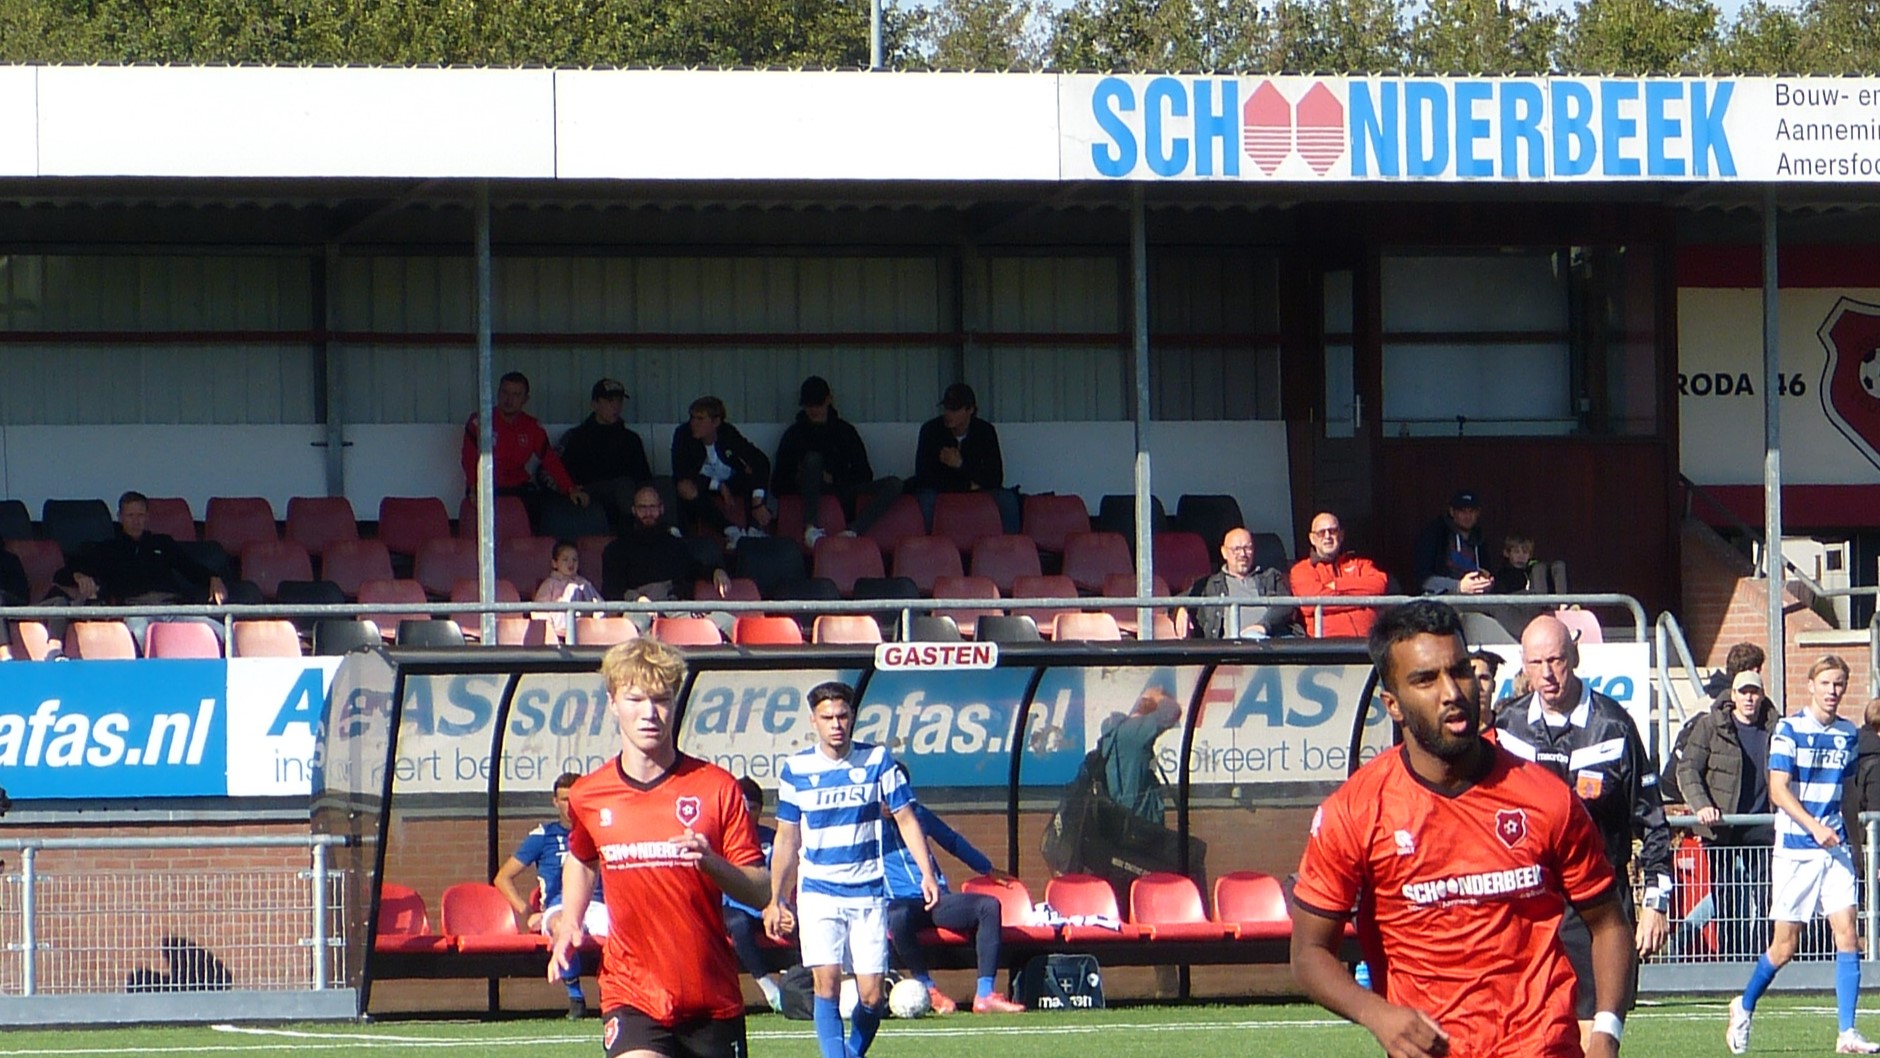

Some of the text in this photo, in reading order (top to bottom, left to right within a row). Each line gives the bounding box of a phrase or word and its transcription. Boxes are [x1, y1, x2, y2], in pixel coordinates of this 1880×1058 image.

[1775, 83, 1849, 106] Bouw-
[884, 645, 991, 667] GASTEN
[0, 697, 216, 768] afas.nl
[853, 689, 1072, 754] afas.nl
